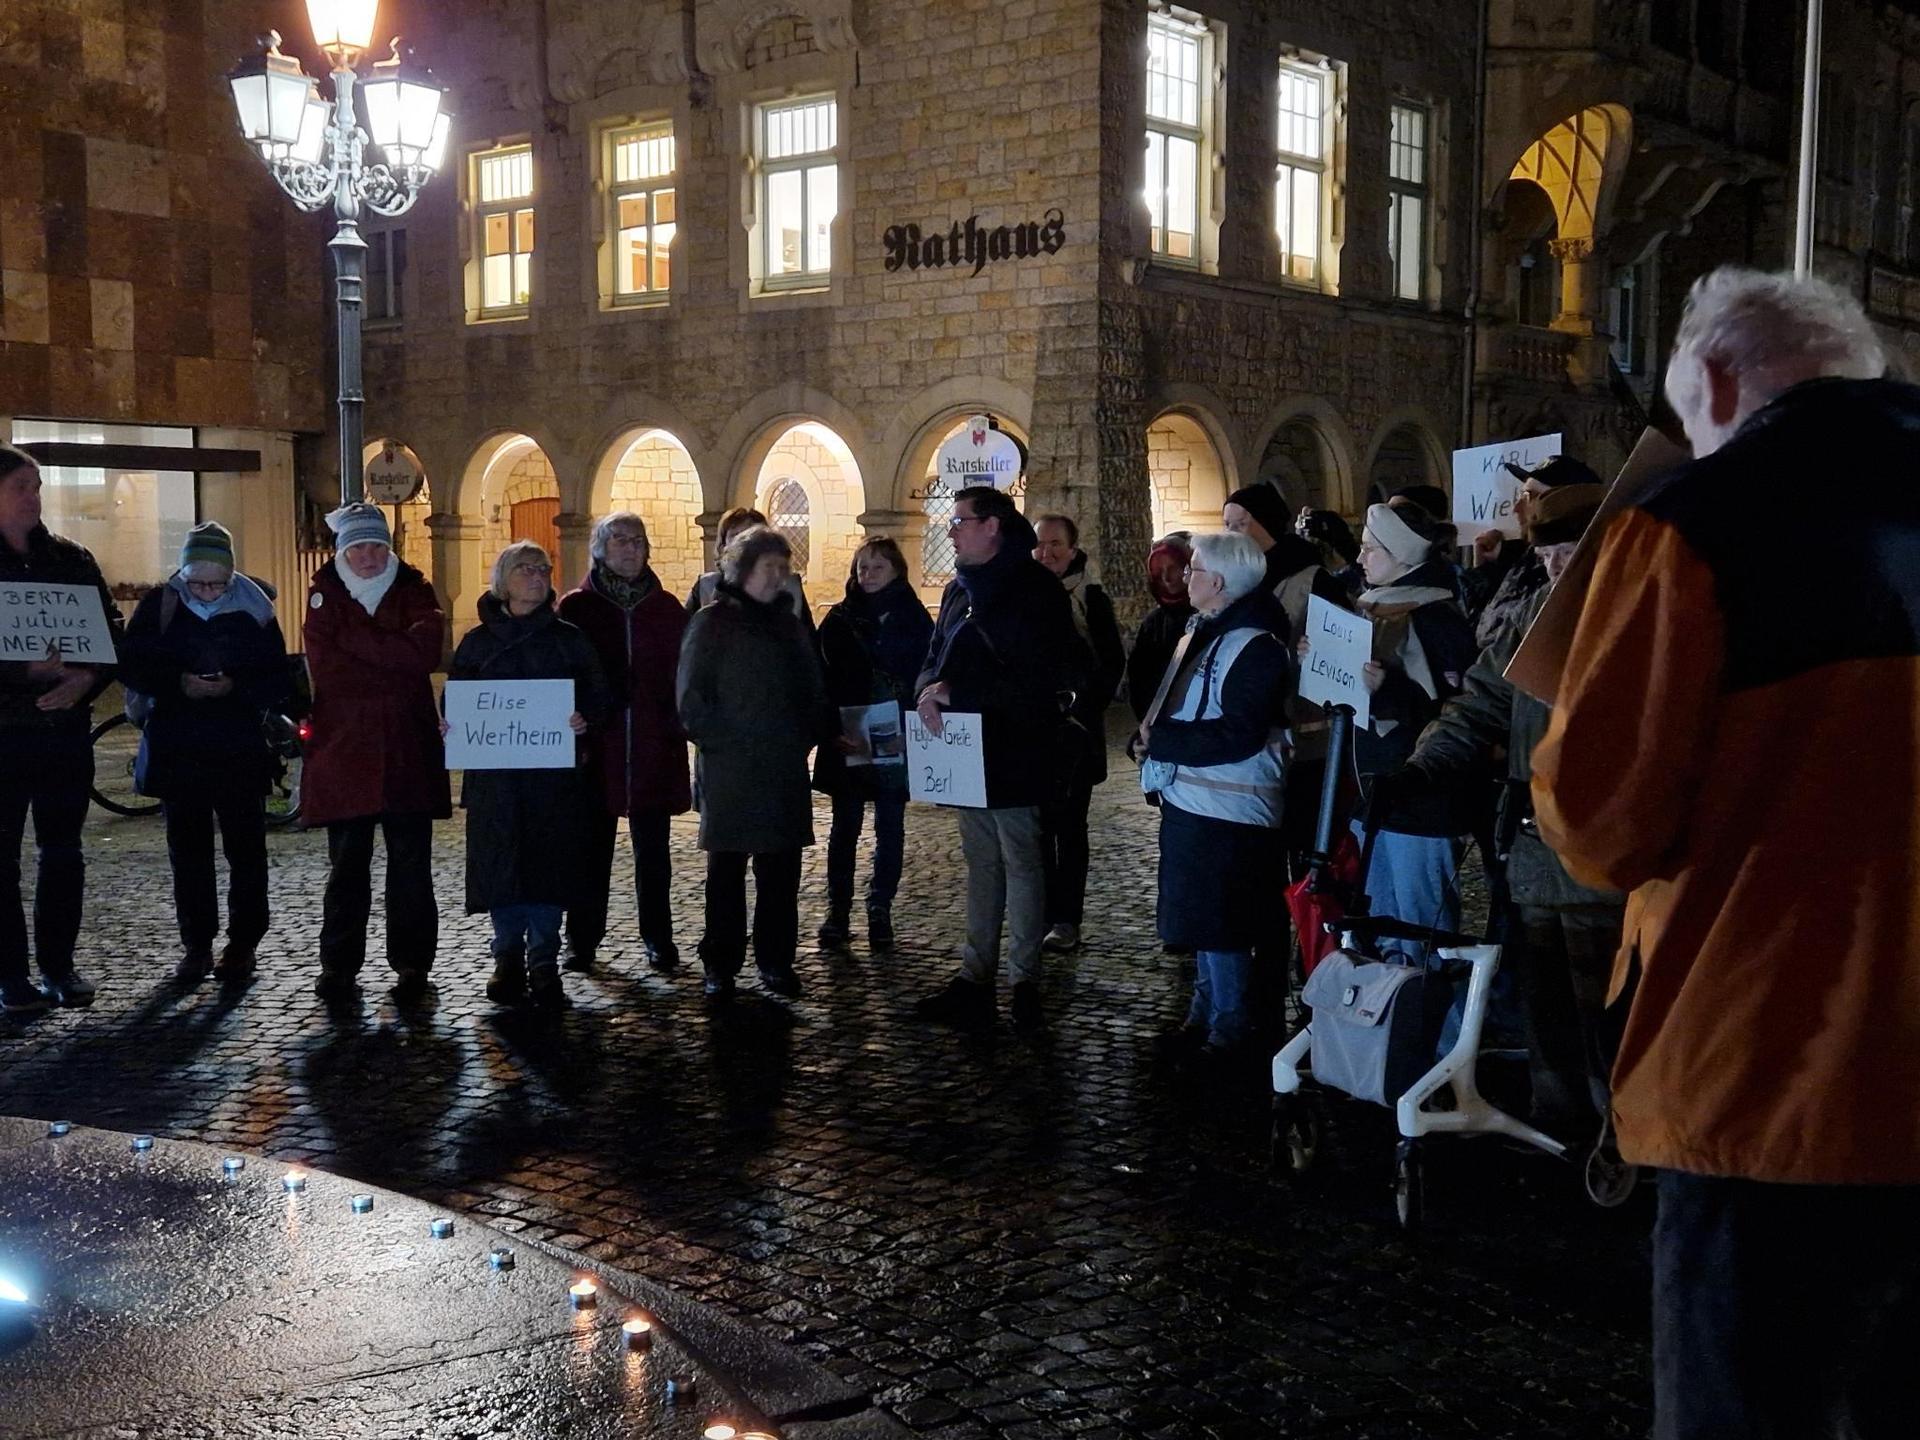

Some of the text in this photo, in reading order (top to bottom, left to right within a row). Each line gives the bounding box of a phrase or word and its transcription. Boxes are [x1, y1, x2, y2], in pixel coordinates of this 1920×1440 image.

[883, 207, 1066, 278] Rathaus
[946, 455, 1013, 474] Ratskeller
[1482, 449, 1536, 473] KARL
[3, 590, 80, 606] BERTA
[2, 634, 92, 654] MEYER
[1311, 650, 1356, 692] Levison
[476, 691, 527, 710] Elise
[465, 719, 563, 746] Wertheim
[923, 764, 953, 794] Berl
